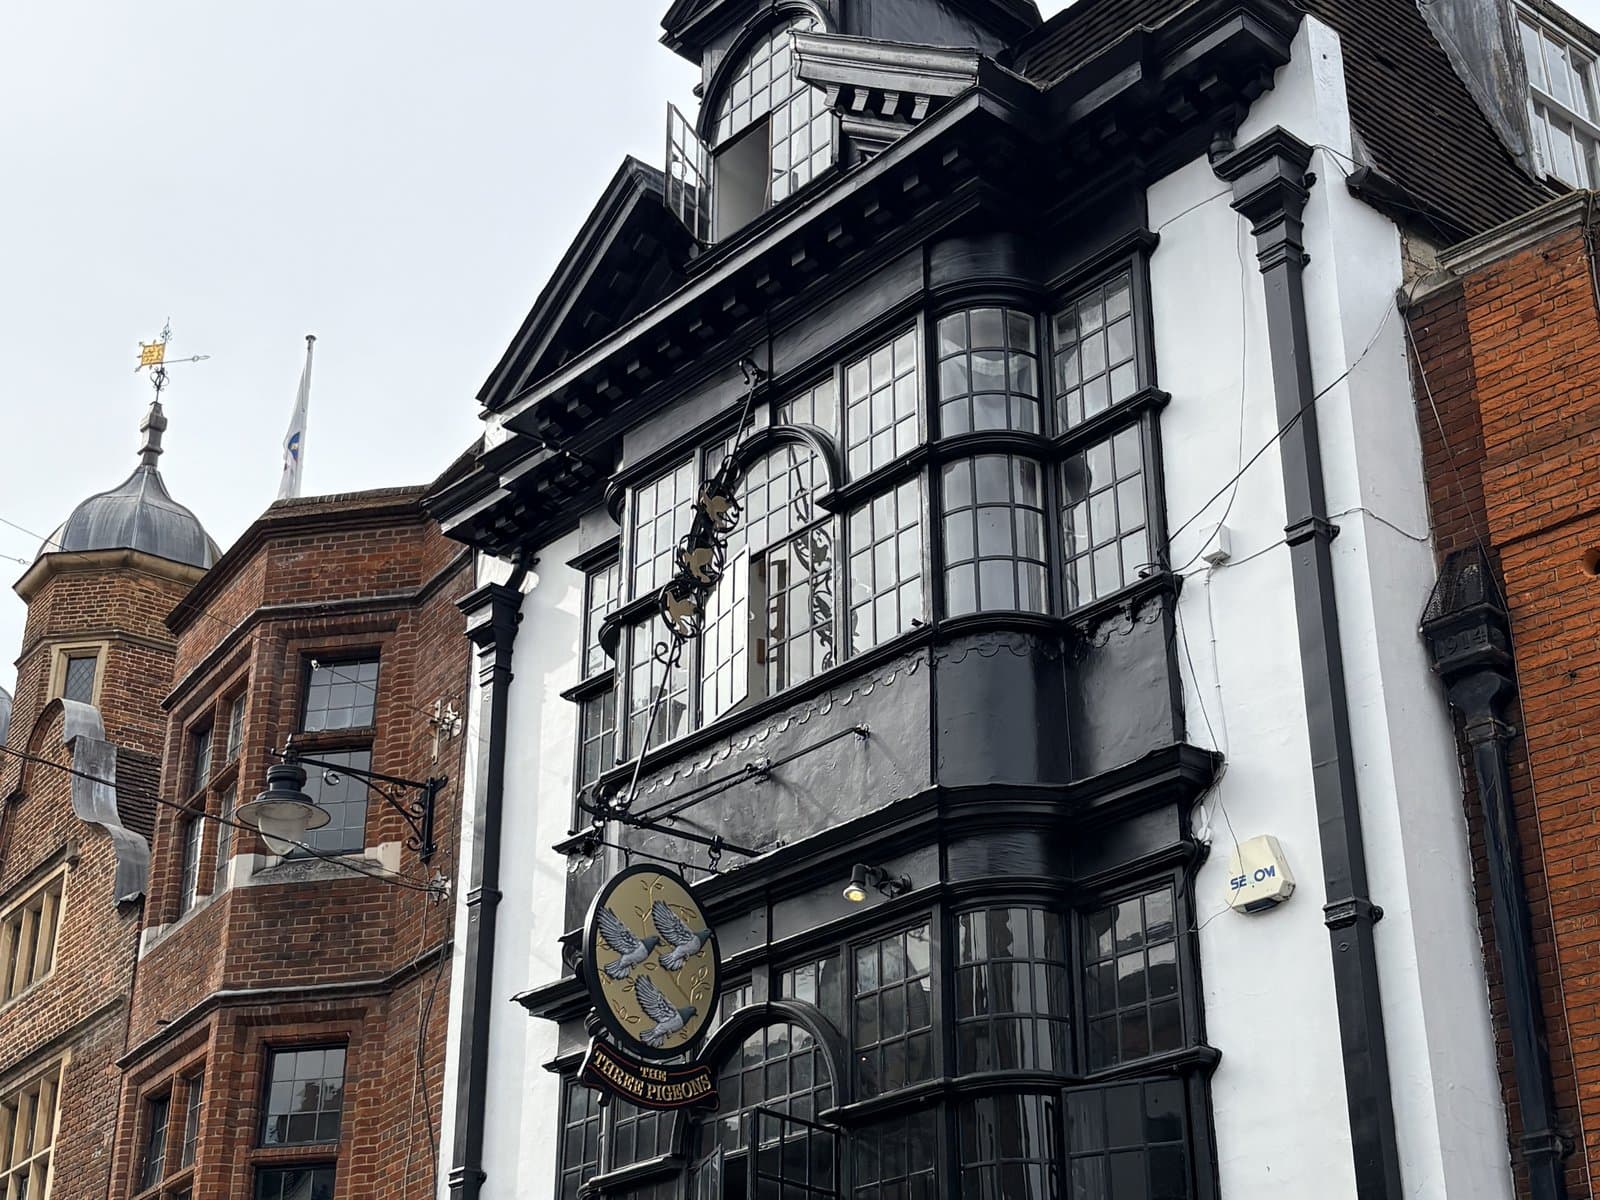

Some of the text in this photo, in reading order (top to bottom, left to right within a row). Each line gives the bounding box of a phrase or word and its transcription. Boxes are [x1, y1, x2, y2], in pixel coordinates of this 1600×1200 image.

[1230, 865, 1276, 890] SEOM
[593, 1050, 712, 1101] THREE PIGEONS
[640, 1066, 667, 1082] THE
